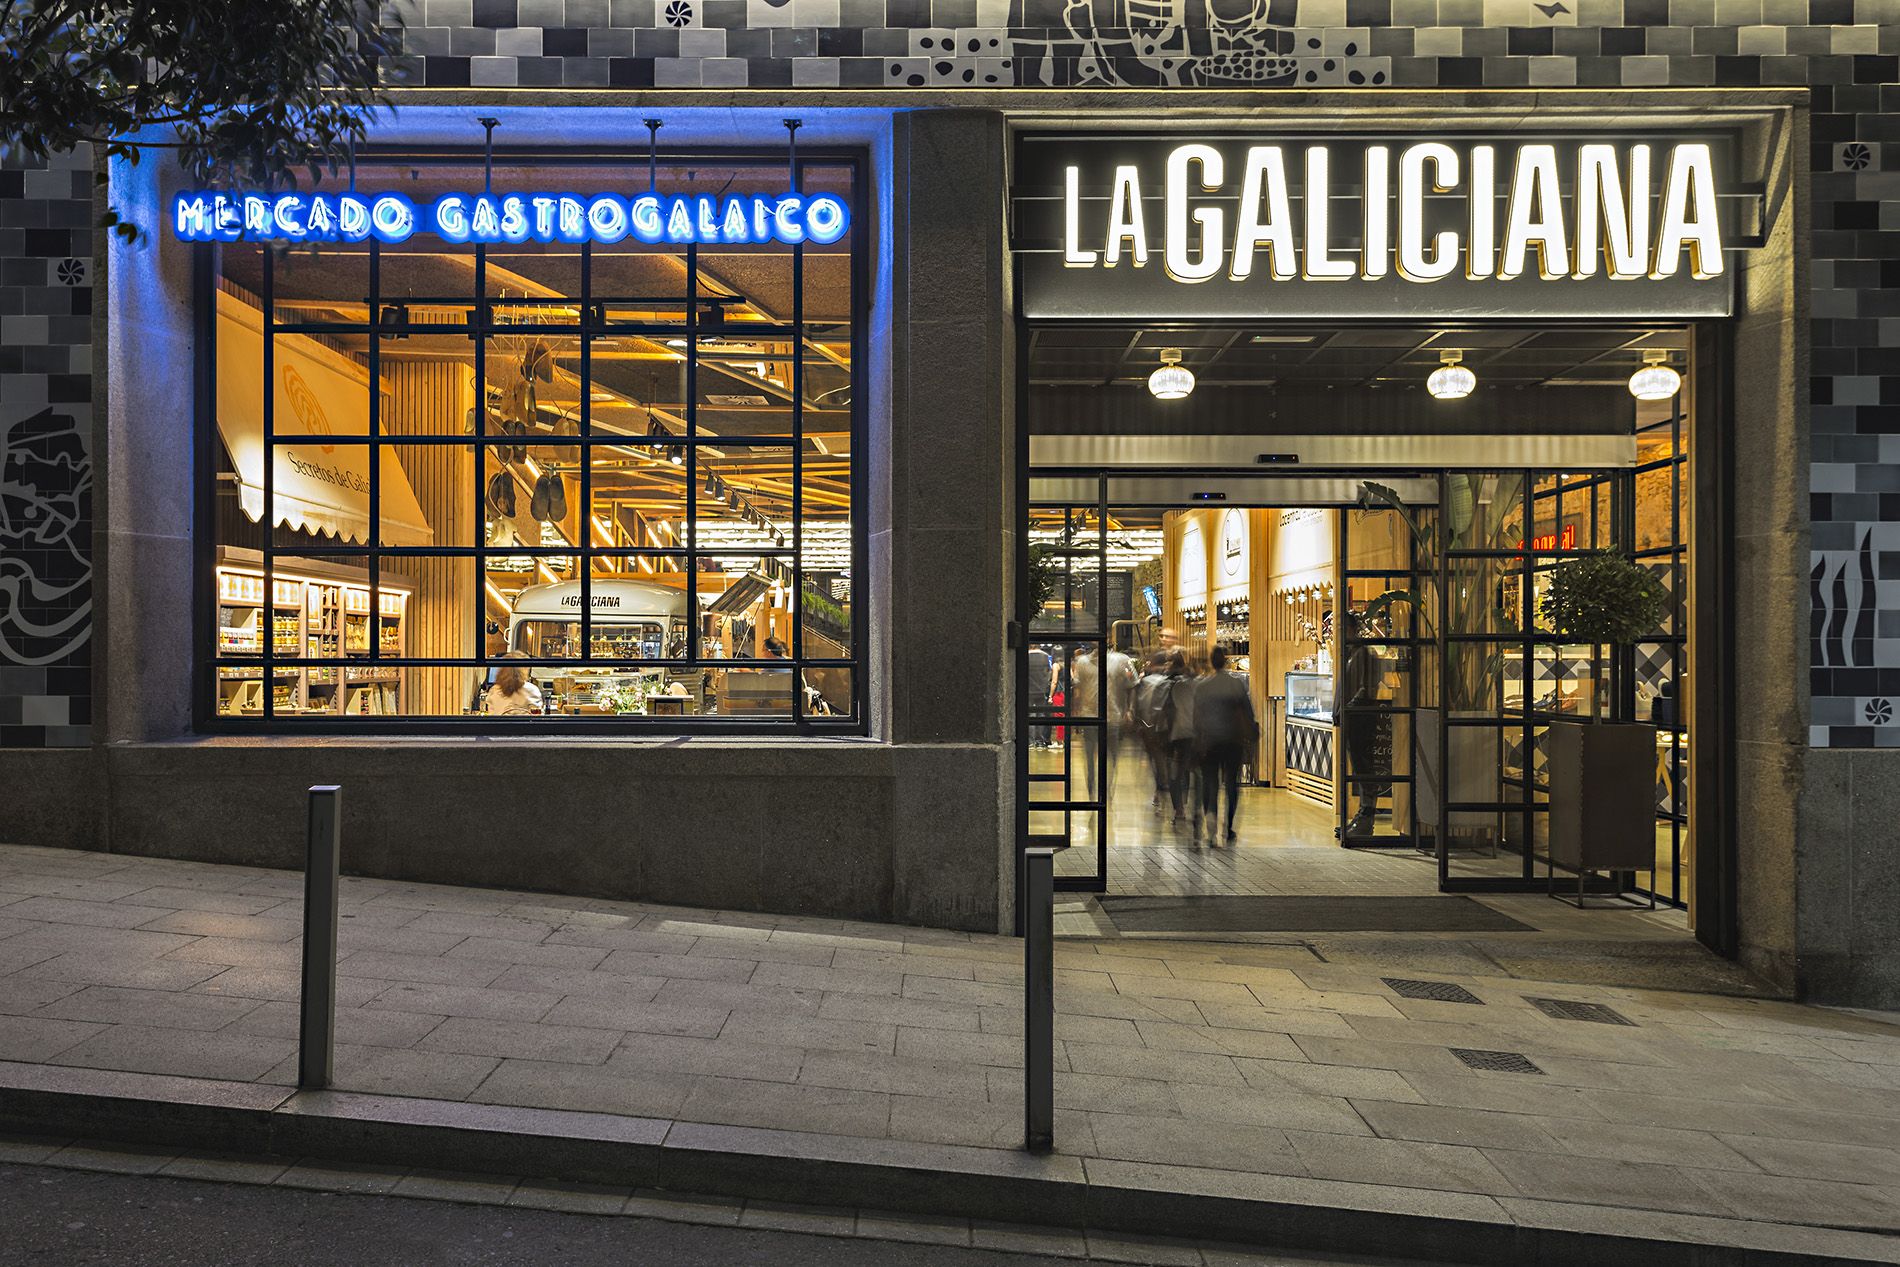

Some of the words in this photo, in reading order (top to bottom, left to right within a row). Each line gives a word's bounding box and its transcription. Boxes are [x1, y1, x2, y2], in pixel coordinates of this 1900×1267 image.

[176, 195, 413, 235] MERCADO
[436, 195, 844, 237] GASTROGALAICO
[1064, 165, 1149, 267] LA
[1164, 143, 1725, 283] GALICIANA
[287, 451, 335, 484] Secretos
[570, 595, 620, 608] GACIANA
